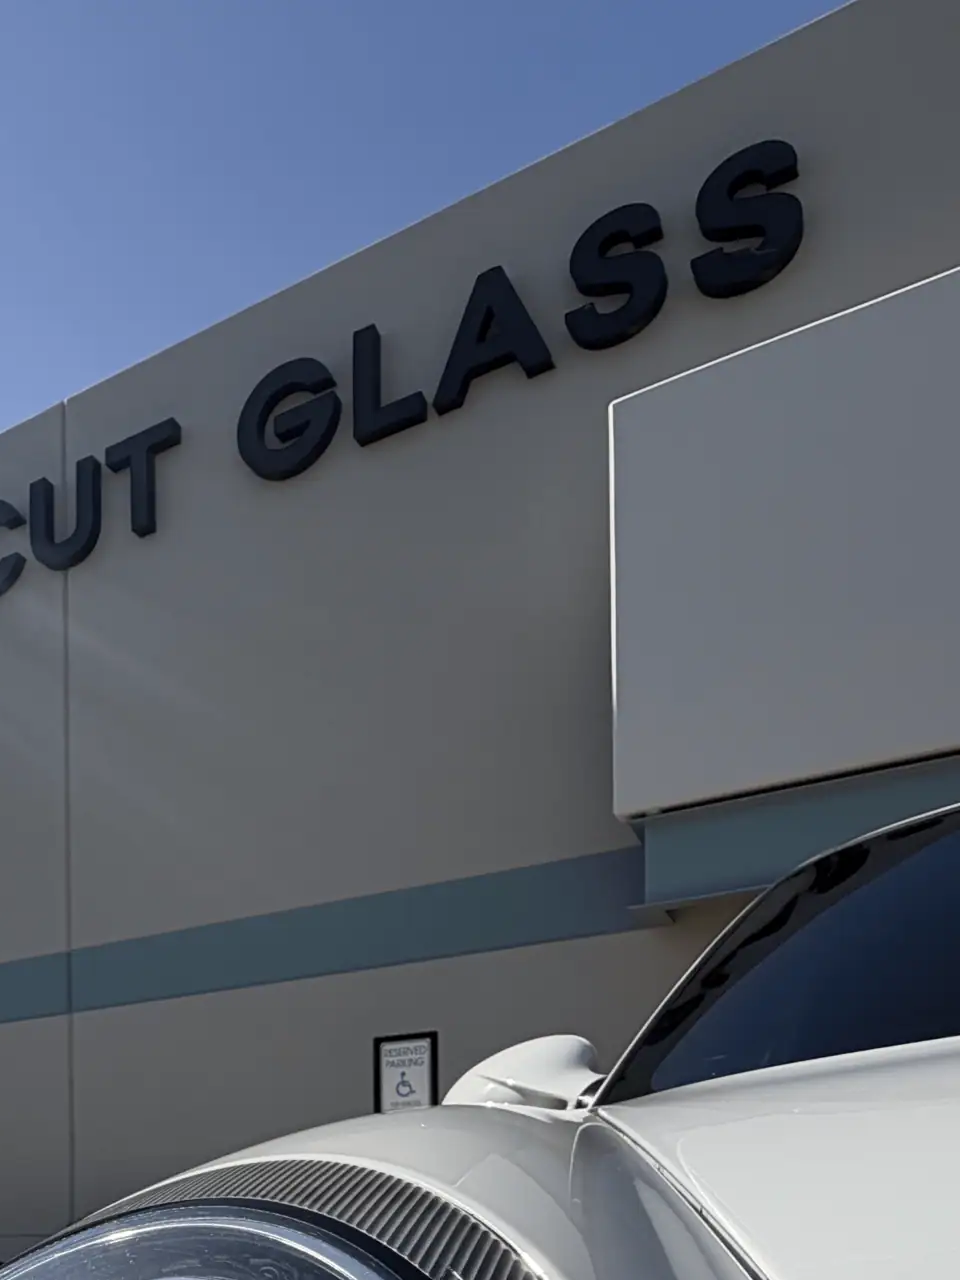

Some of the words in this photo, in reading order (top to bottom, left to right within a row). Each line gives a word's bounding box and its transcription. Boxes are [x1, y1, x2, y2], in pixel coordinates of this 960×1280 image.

[237, 139, 804, 481] GLASS
[383, 1045, 428, 1058] RESERVED
[385, 1057, 425, 1068] PARKING
